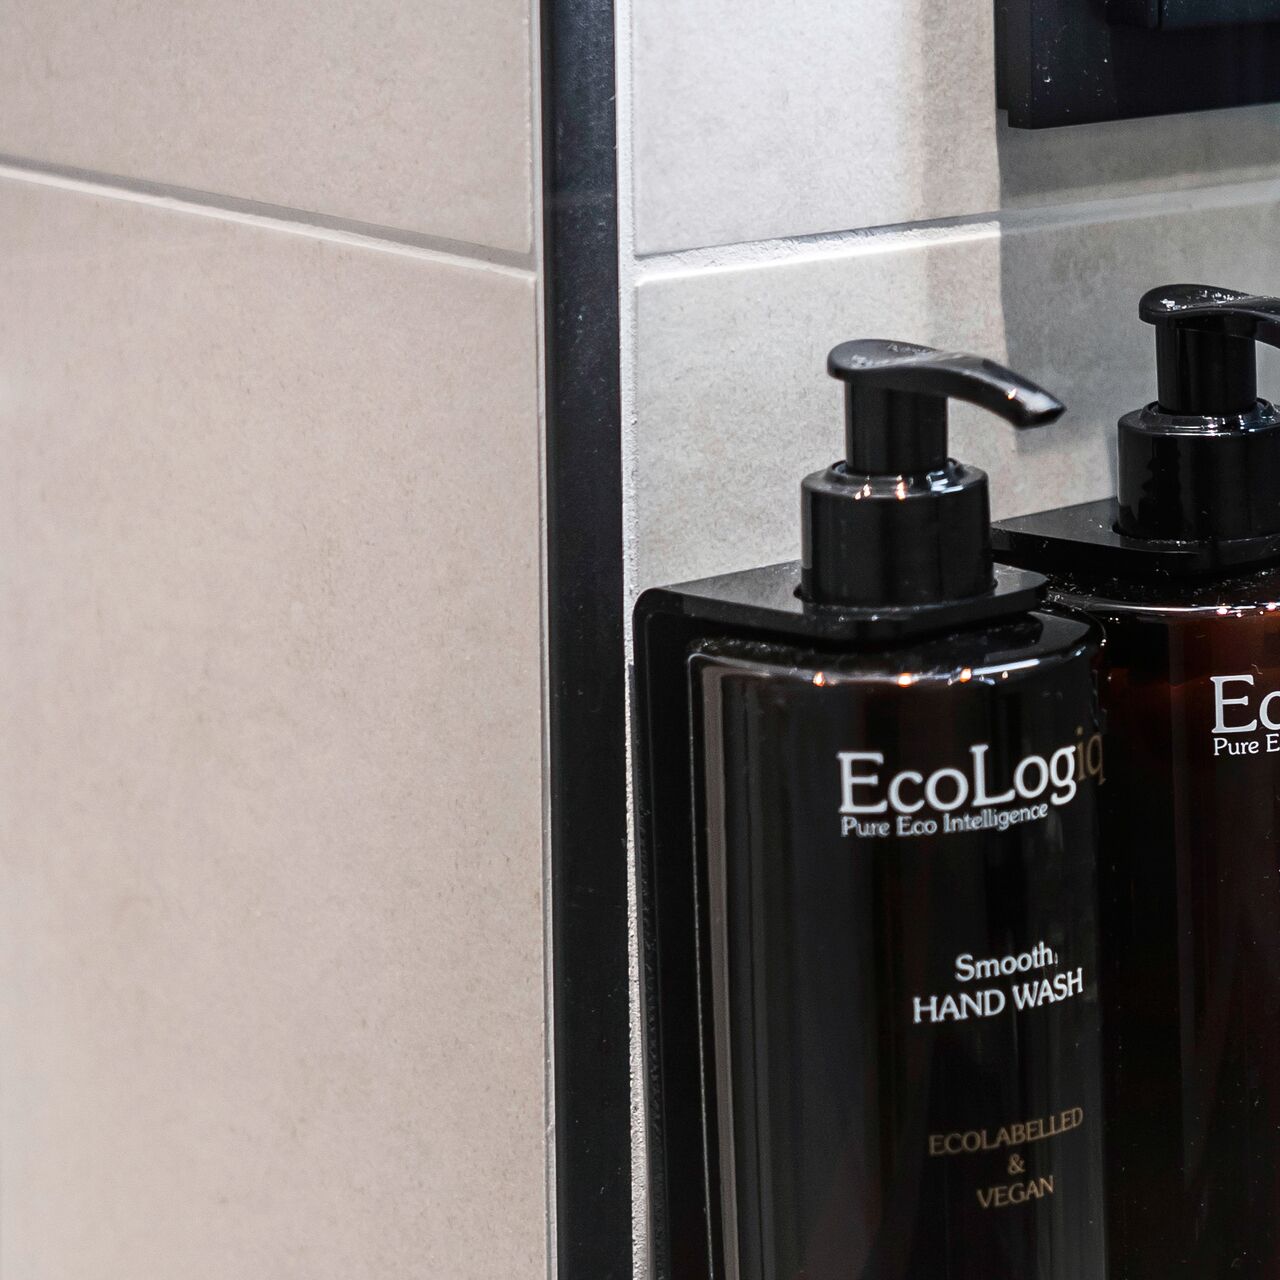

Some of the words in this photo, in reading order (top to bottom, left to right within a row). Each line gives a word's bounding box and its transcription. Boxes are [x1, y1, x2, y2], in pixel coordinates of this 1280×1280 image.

[1213, 737, 1260, 756] Pure
[840, 815, 891, 838] Pure
[896, 815, 938, 837] Eco
[942, 802, 1049, 831] Intelligence
[954, 940, 1054, 983] Smooth
[912, 988, 1006, 1025] HAND
[1011, 966, 1084, 1021] WASH
[928, 1106, 1085, 1157] ECOLABELLED
[1007, 1152, 1027, 1176] &
[975, 1174, 1055, 1209] VEGAN
